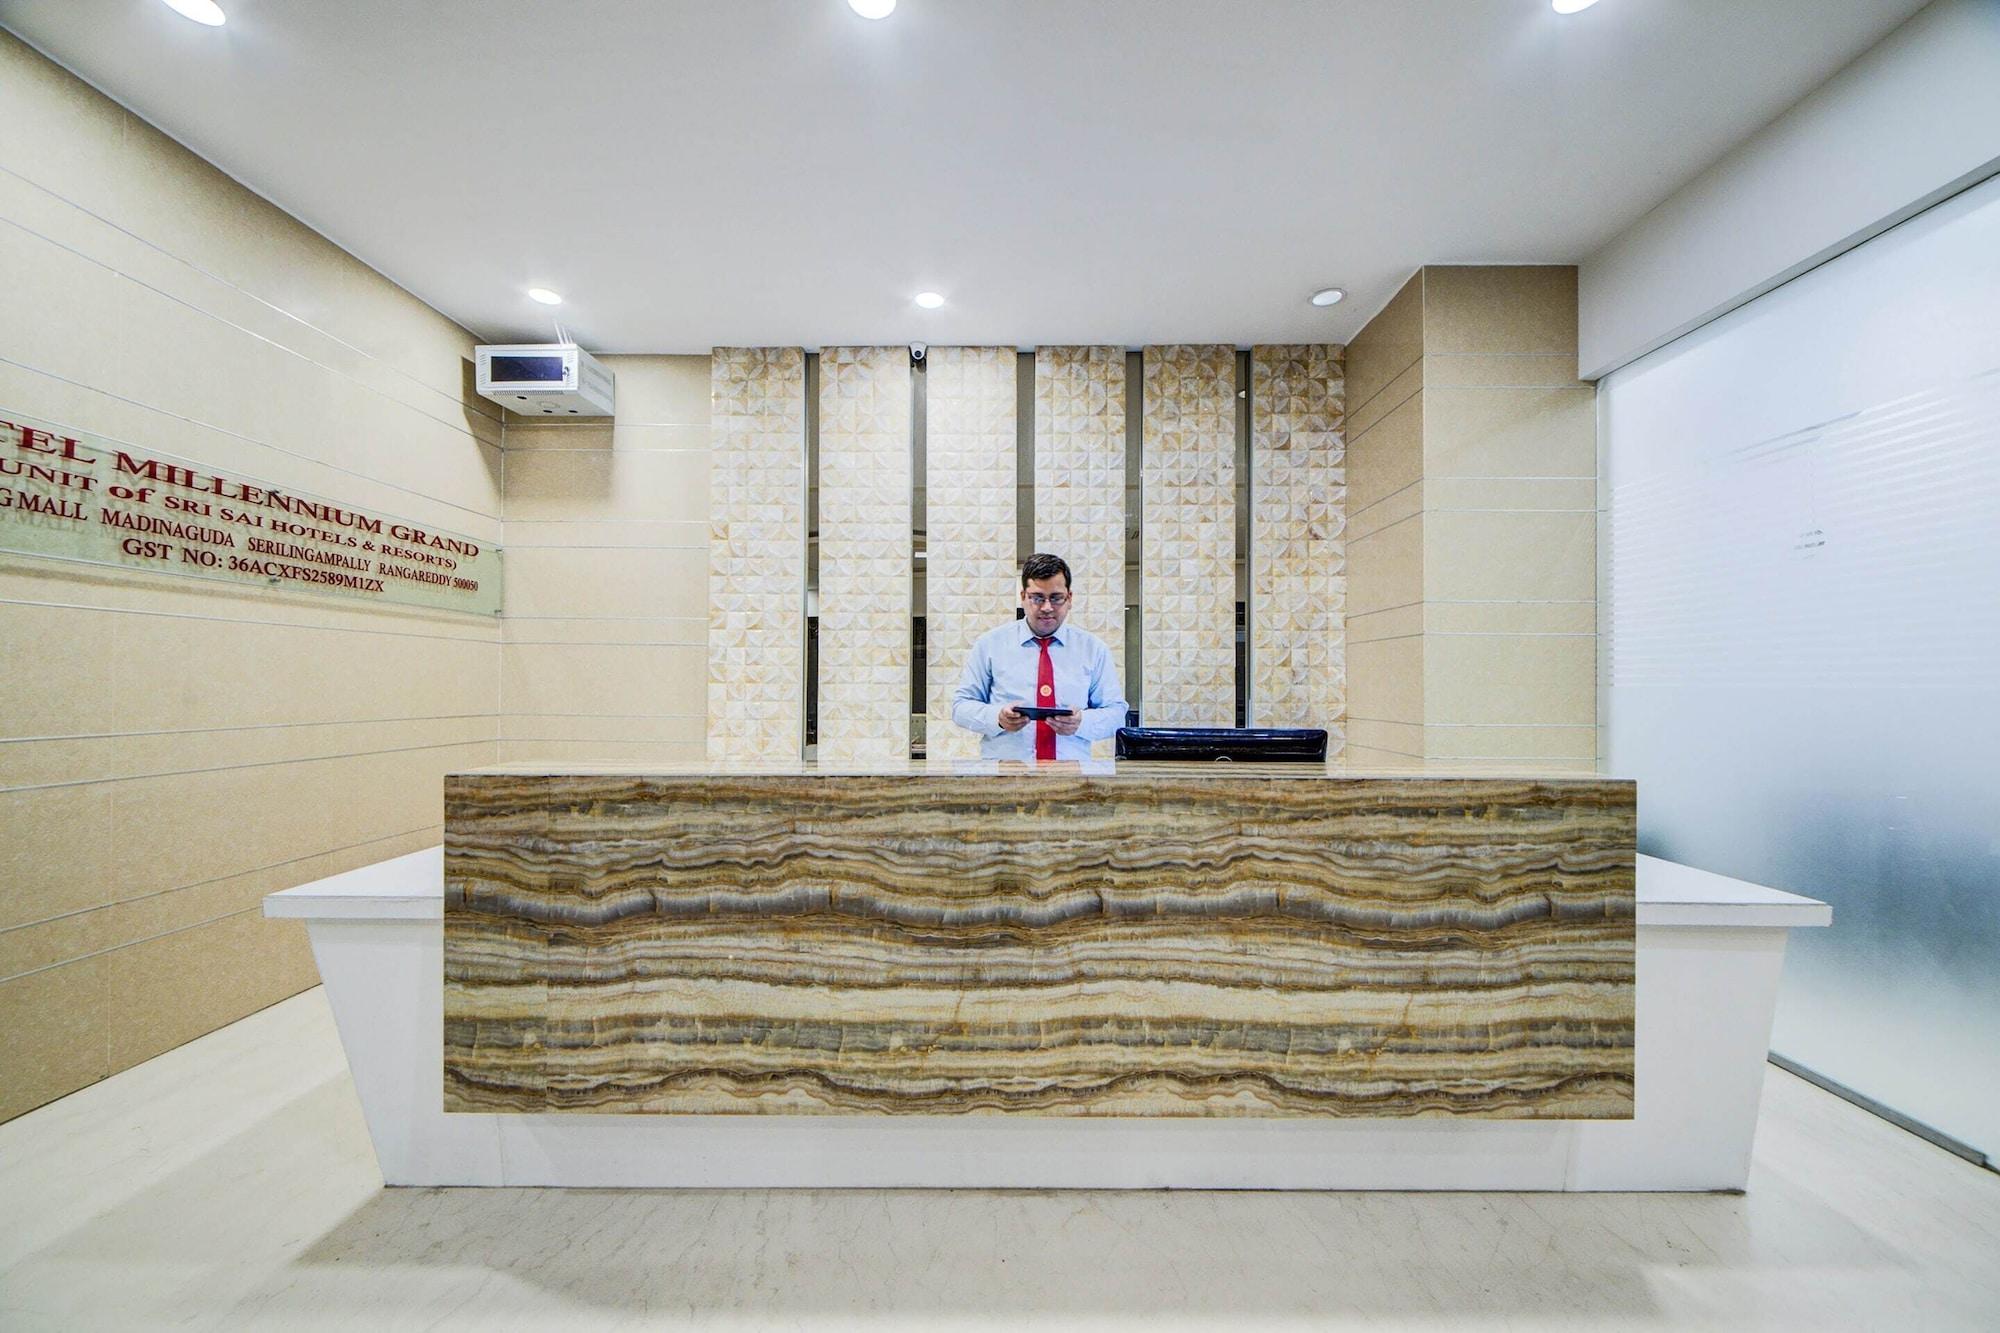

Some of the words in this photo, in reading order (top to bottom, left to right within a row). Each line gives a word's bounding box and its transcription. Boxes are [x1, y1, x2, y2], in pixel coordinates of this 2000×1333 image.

[0, 420, 97, 464] EL
[112, 450, 383, 534] MILLENNIUM
[391, 524, 480, 558] GRAND
[0, 458, 98, 491] UNIT
[271, 519, 358, 549] HOTELS
[362, 540, 376, 552] &
[382, 544, 457, 571] RESORTS)
[17, 491, 88, 521] MALL
[101, 508, 235, 548] MADINAGUDA
[248, 537, 371, 572] SERILINGAMPALLY
[379, 563, 452, 587] RANGAREDDY
[453, 577, 479, 592] 500050
[122, 538, 173, 561] GST
